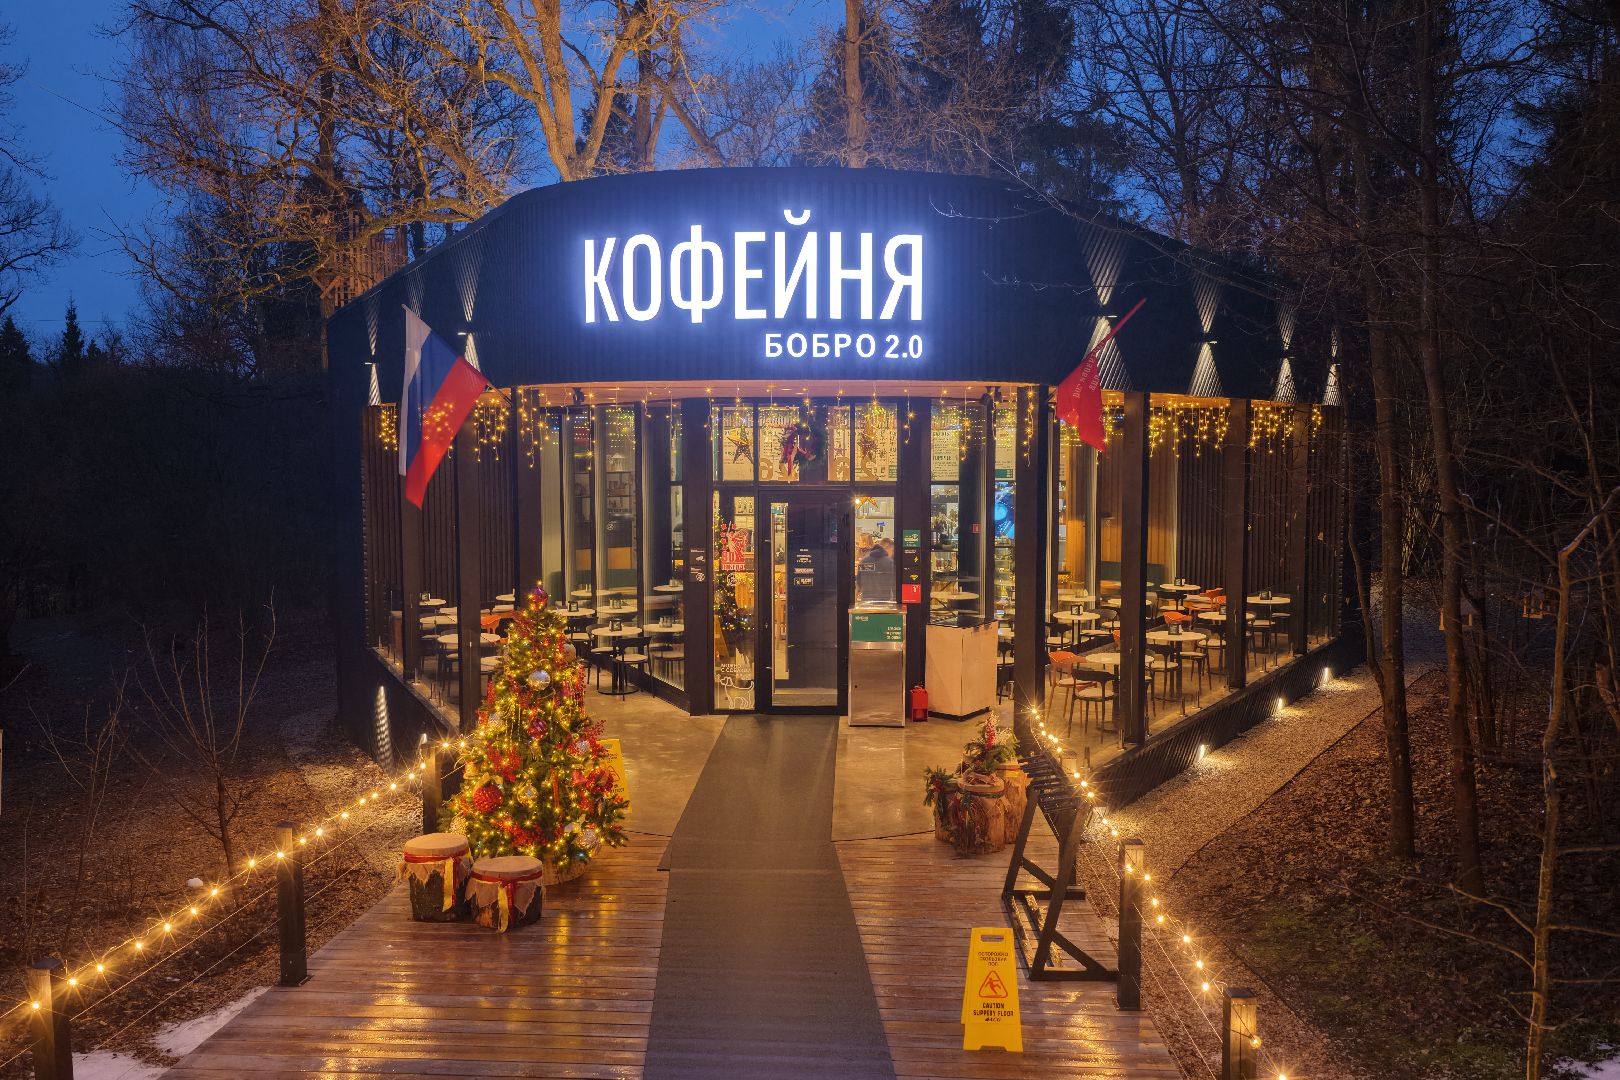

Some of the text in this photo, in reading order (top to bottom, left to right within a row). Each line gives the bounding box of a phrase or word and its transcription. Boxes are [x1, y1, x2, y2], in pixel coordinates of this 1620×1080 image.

[584, 209, 923, 324] КОФЕЙНЯ
[765, 332, 923, 359] БОБРО 2.0
[973, 1009, 996, 1017] SLIPPERY
